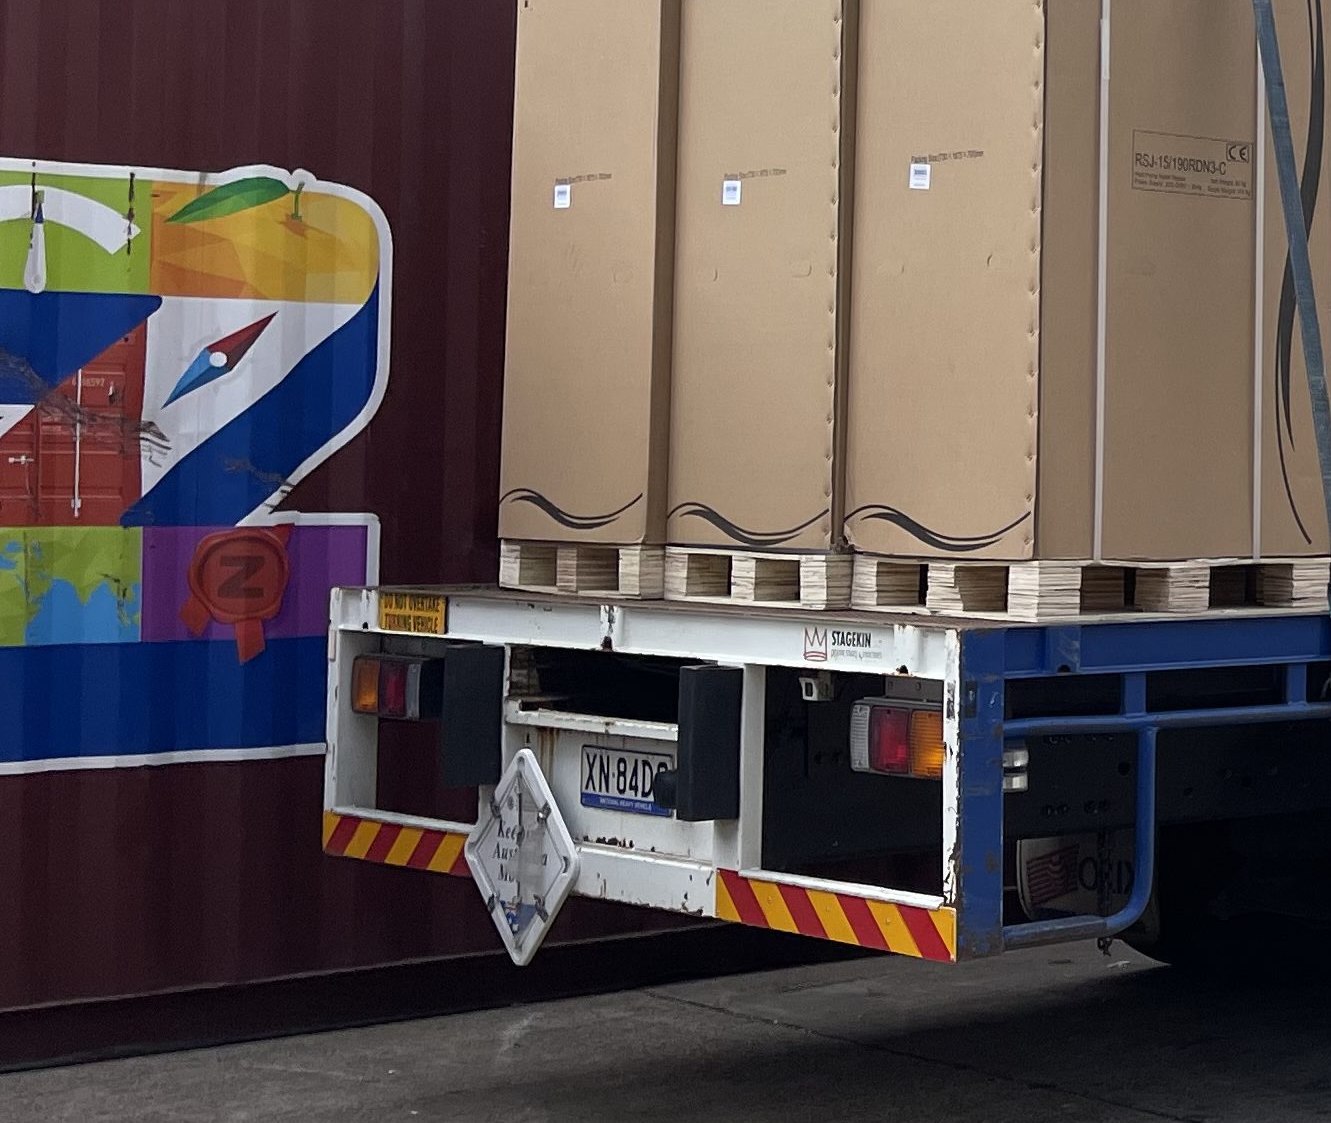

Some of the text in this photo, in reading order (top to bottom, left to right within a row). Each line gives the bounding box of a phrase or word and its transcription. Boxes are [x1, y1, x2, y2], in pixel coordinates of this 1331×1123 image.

[1135, 152, 1227, 176] RSJ-15/190RDN3-C
[218, 556, 265, 598] Z
[384, 594, 440, 612] DO NOT OVERTAKE
[385, 613, 438, 634] TURNING VEHICLE
[831, 630, 872, 648] STAGEKIN
